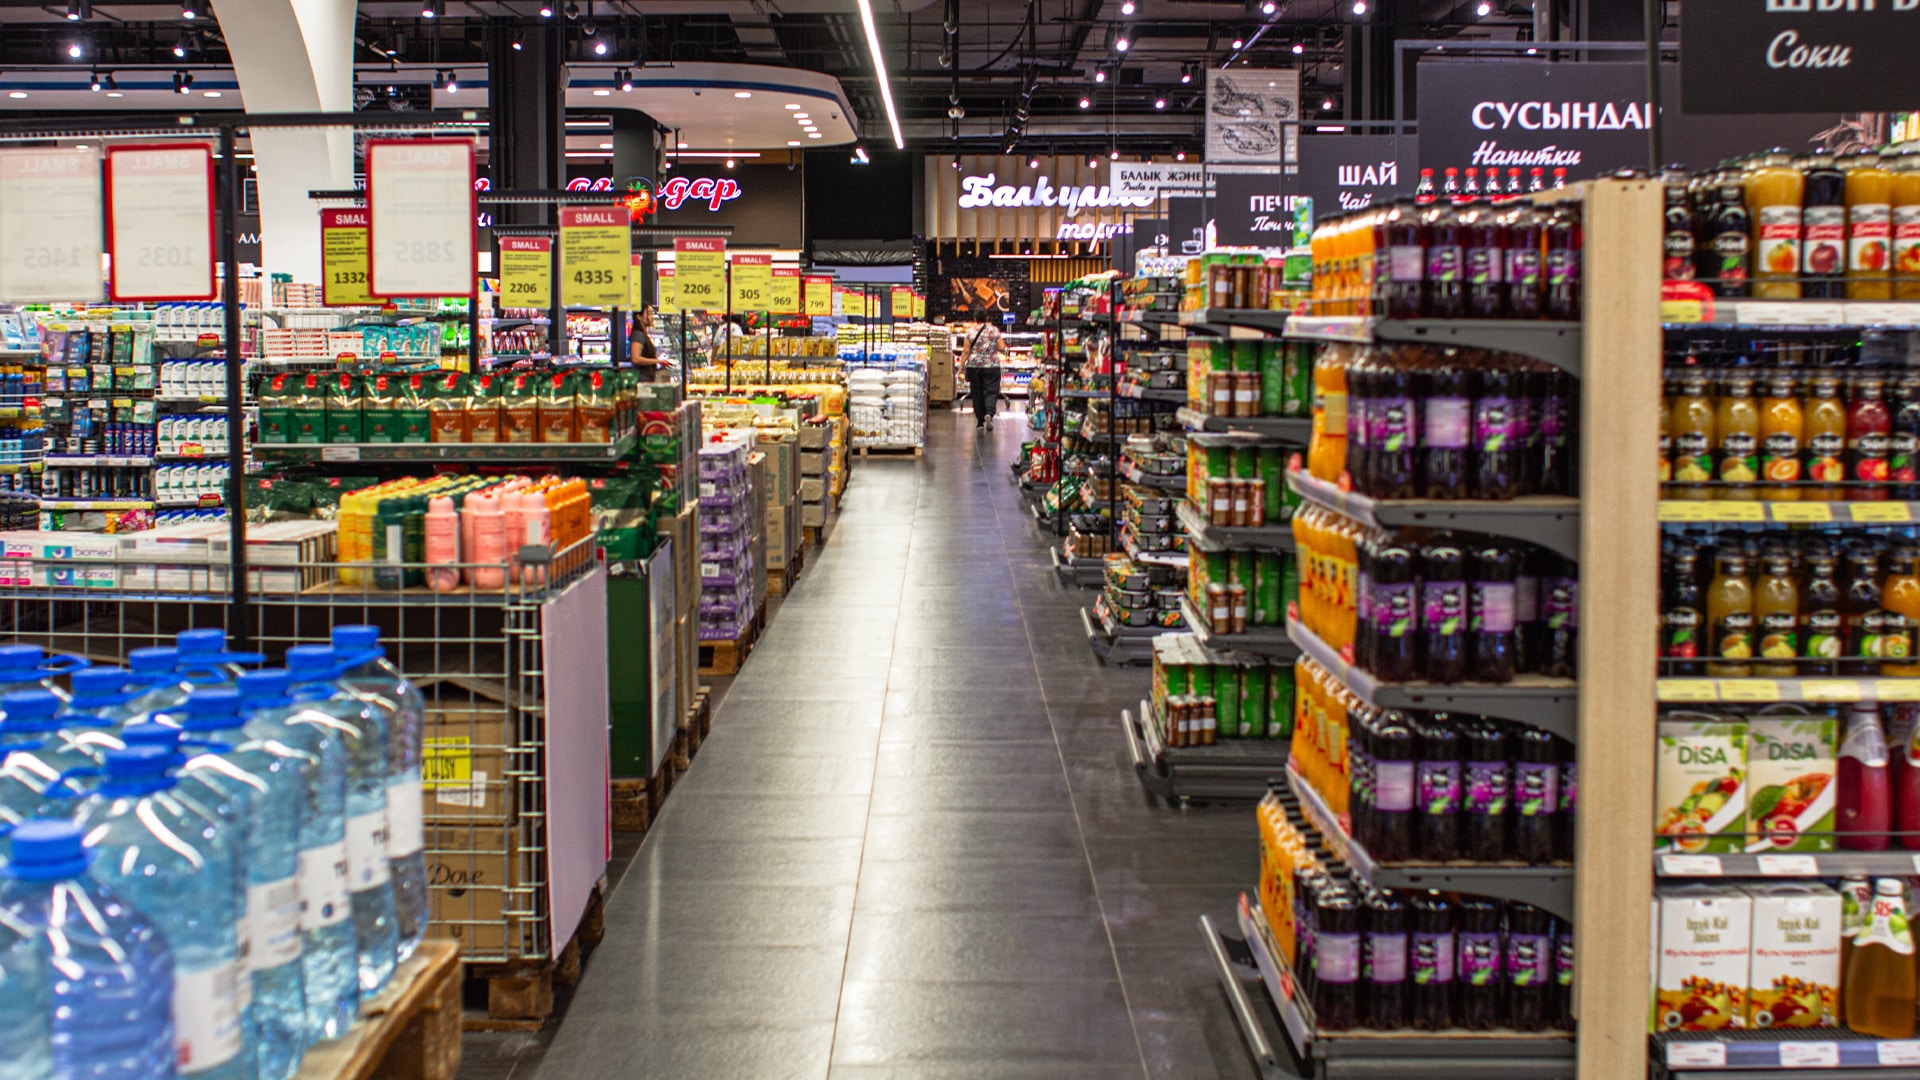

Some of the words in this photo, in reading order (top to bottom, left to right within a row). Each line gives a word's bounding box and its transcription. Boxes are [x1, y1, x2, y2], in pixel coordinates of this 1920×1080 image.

[1766, 29, 1852, 68] Соки
[1472, 140, 1581, 166] Напитки
[1338, 161, 1397, 186] ШАЙ
[1339, 190, 1372, 210] Чай
[335, 214, 367, 225] SMAL
[575, 213, 615, 223] SMALL
[511, 241, 540, 249] SMALL
[685, 242, 715, 250] SMALL
[574, 270, 613, 284] 4335
[509, 283, 537, 294] 2206
[683, 284, 711, 295] 2206
[739, 290, 760, 300] 305
[774, 297, 791, 305] 969
[74, 546, 112, 557] biomed
[428, 863, 484, 886] Dove
